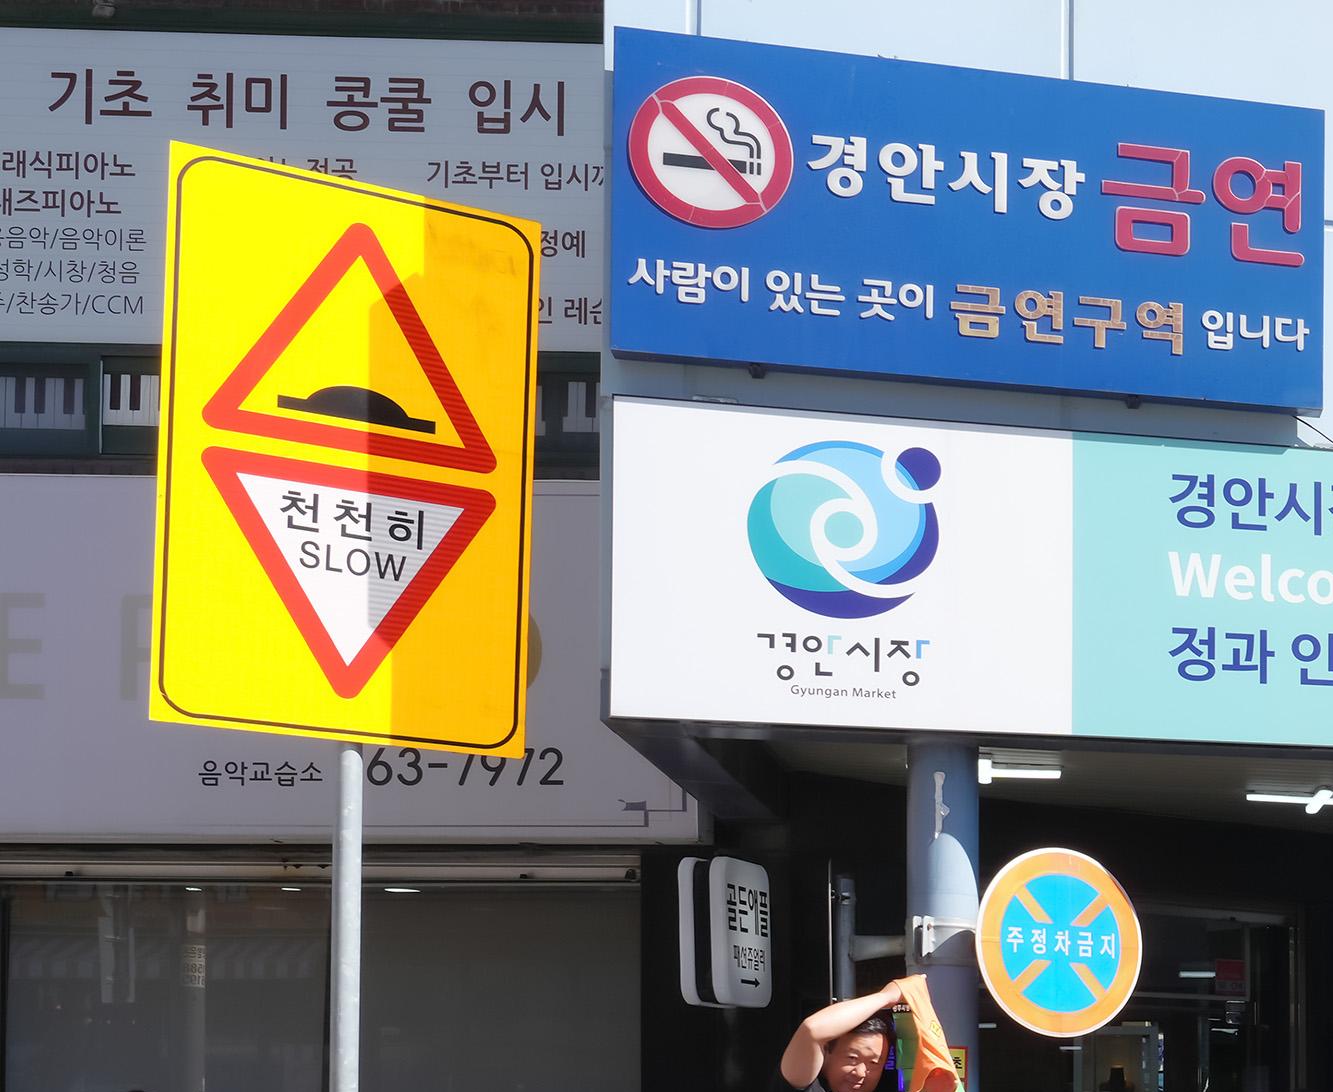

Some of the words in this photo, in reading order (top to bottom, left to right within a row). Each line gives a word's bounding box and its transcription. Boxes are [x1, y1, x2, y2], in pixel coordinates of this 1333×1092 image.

[48, 68, 152, 125] 기초
[186, 72, 288, 130] 취미
[326, 76, 432, 133] 콩쿨
[468, 79, 566, 136] 입시
[427, 160, 529, 189] 기초부터
[806, 134, 1085, 220] 경안시장
[1100, 142, 1306, 267] 금연
[0, 226, 147, 251] 음악/음악이론
[0, 292, 144, 316] /찬송가/CCM
[628, 256, 750, 305] 사람이
[765, 269, 846, 314] 있는
[857, 278, 935, 323] 곳이
[950, 283, 1185, 356] 금연구역
[1200, 308, 1310, 352] 입니다
[279, 489, 425, 550] 천천히
[299, 541, 407, 582] SLOW
[756, 632, 930, 687] 경안시장
[1168, 625, 1276, 685] 정과
[790, 684, 848, 699] Gyungan
[852, 686, 897, 700] Market
[198, 758, 324, 787] 음악교습소
[727, 882, 770, 938] 골든애플
[732, 943, 766, 974] 패션쥬얼리
[1006, 924, 1117, 959] 주정차금지
